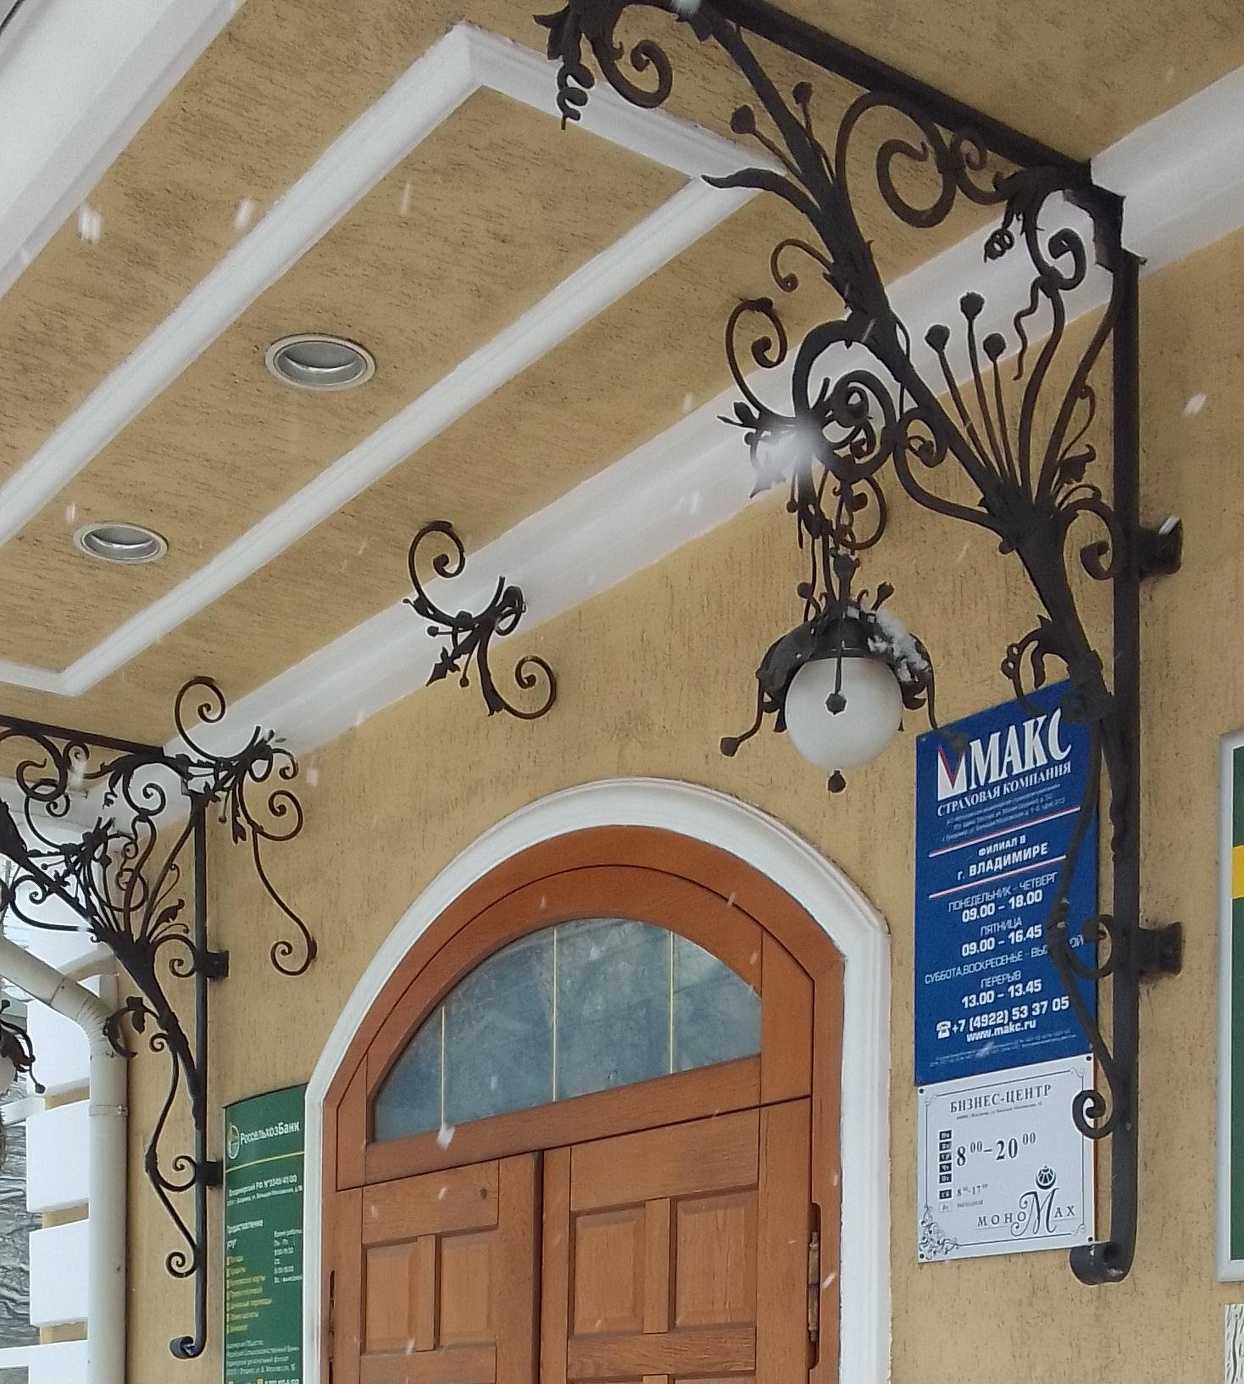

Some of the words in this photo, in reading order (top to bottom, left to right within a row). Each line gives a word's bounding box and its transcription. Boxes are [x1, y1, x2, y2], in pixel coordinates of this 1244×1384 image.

[968, 707, 1072, 790] МАКС
[937, 786, 1001, 817] СТРАХОВАЯ
[1001, 761, 1072, 796] КОМПАНИЯ
[969, 842, 1048, 878] ВЛАДИМИРЕ
[978, 838, 1018, 857] ФИЛИАЛ
[948, 885, 1012, 912] ПОНЕДЕЛЬНИК
[1019, 872, 1058, 891] ЧЕТВЕРГ
[961, 902, 996, 923] 09.00
[1008, 890, 1043, 909] 18.00
[961, 936, 996, 957] 09.00
[1007, 924, 1043, 945] 16.45
[980, 917, 1023, 937] ПЯТНИЦА
[961, 988, 995, 1009] 13.00
[1008, 979, 1042, 1000] 13.45
[980, 969, 1022, 989] ПЕРЕРЫВ
[952, 1019, 966, 1036] +7
[969, 1009, 1009, 1033] (4922)
[1012, 1002, 1029, 1020] 53
[1031, 999, 1048, 1017] 37
[1052, 995, 1070, 1012] 05
[966, 1019, 1036, 1043] www.makc.ru
[950, 1084, 1052, 1114] БИЗНЕС-ЦЕНТР
[240, 1121, 300, 1145] РоссельхозБанк
